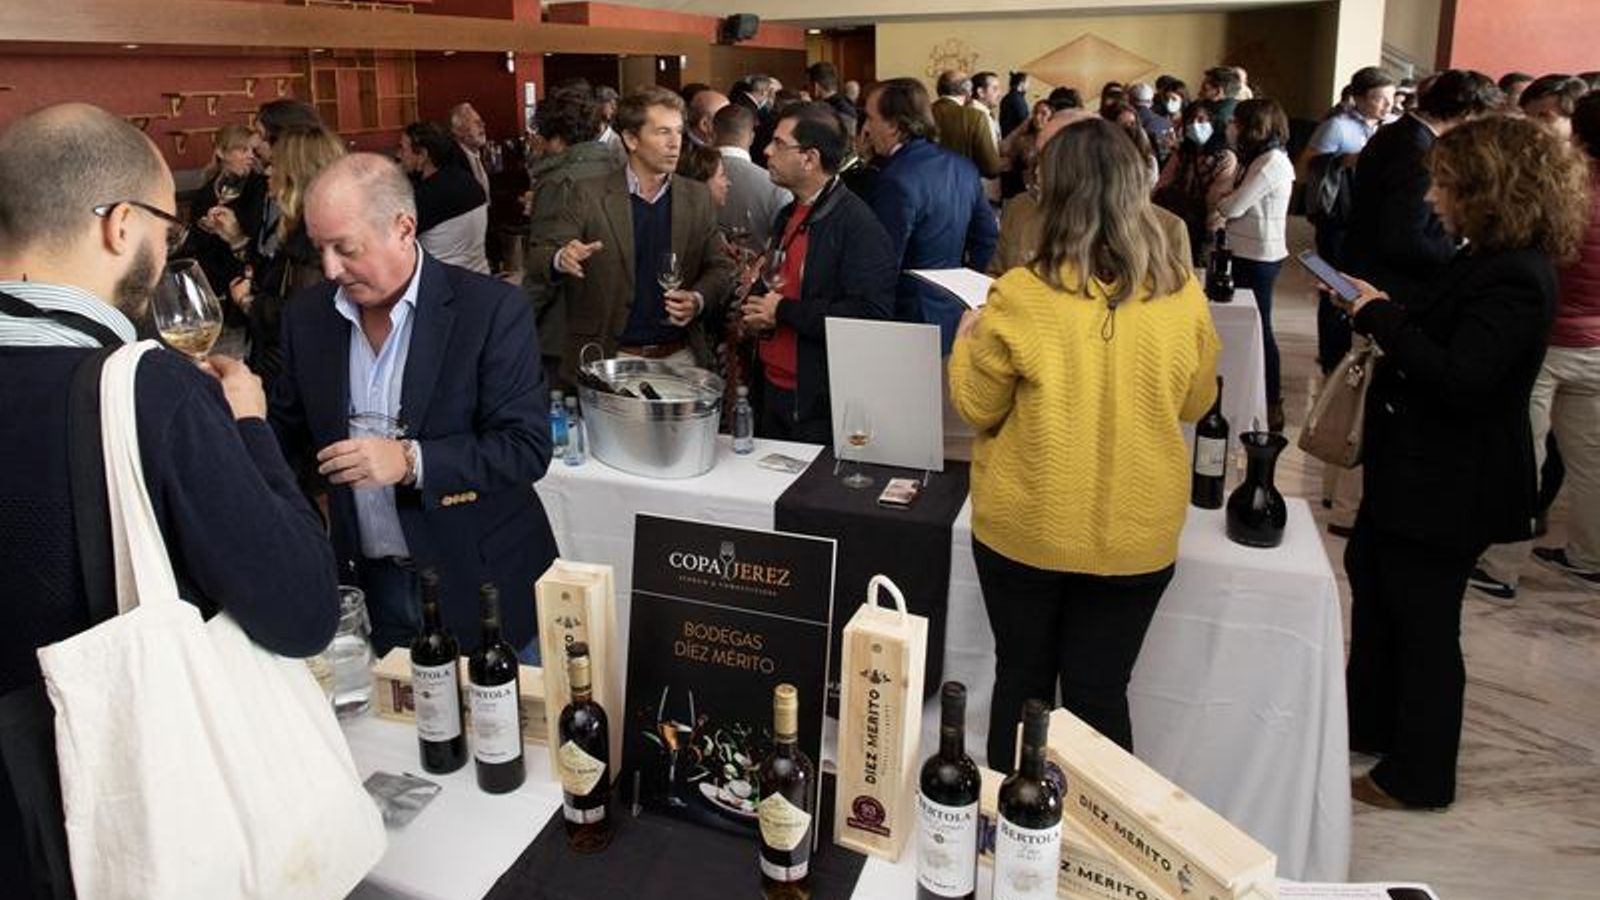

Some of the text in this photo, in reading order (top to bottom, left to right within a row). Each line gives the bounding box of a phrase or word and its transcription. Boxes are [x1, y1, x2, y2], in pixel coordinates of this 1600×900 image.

[668, 551, 721, 575] COPA
[731, 561, 791, 587] JEREZ
[683, 620, 763, 651] BODEGAS
